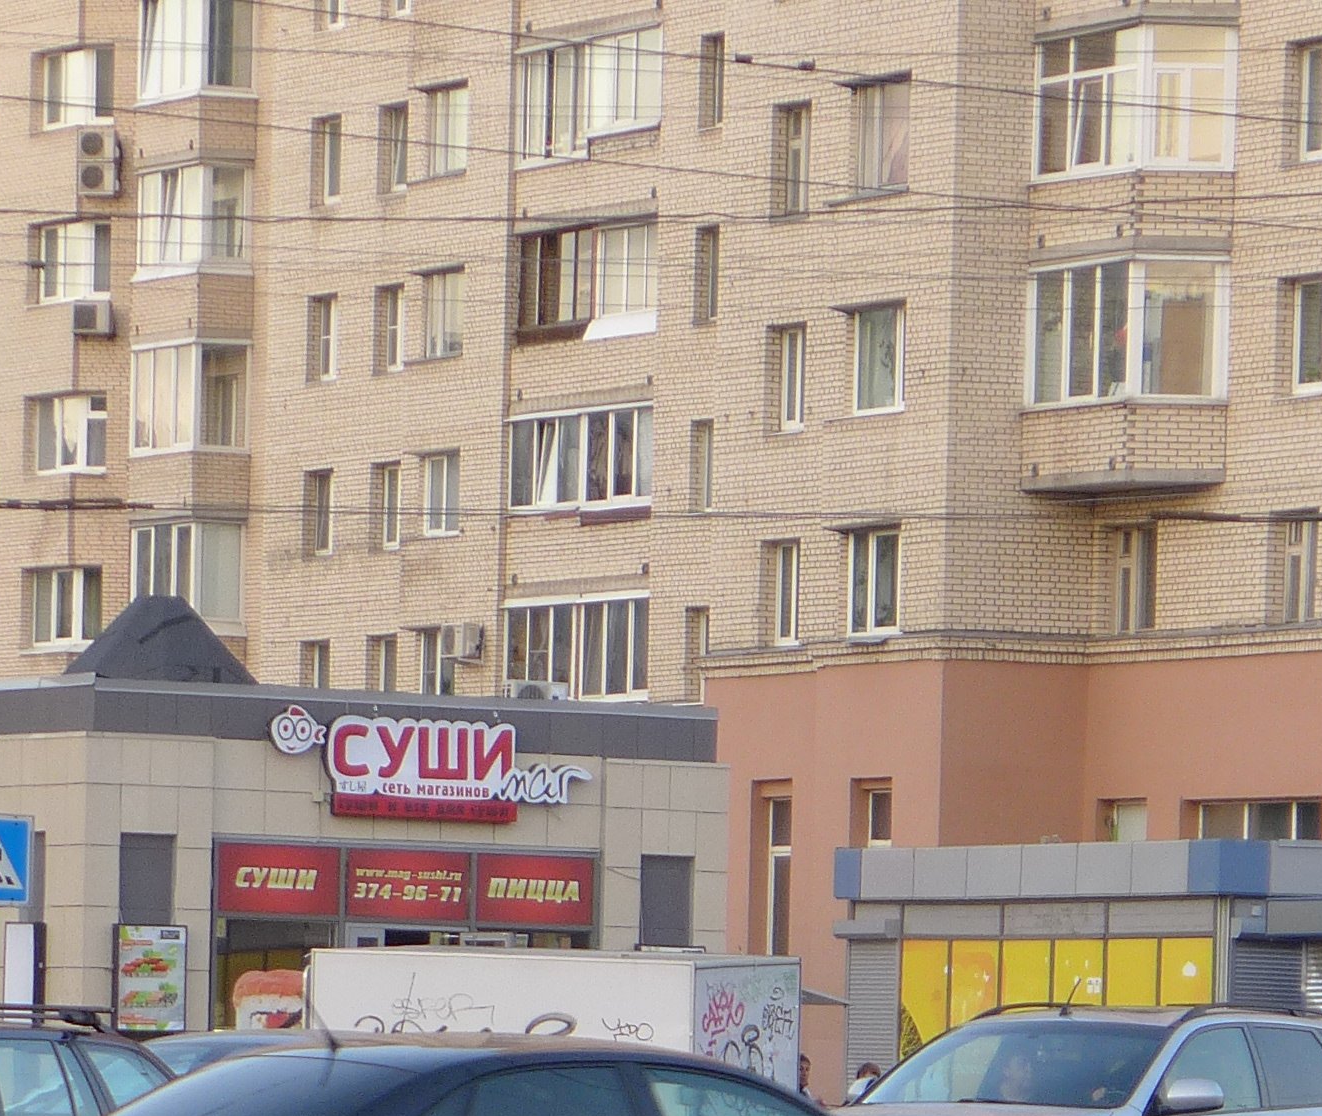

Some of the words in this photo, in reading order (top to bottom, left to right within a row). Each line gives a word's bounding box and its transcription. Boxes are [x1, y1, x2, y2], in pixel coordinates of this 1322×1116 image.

[333, 724, 513, 781] СУШИ
[382, 781, 410, 795] сеть
[417, 783, 490, 799] магазинов
[235, 866, 318, 890] СУШИ
[486, 876, 581, 904] ПИЦЦА
[354, 882, 461, 902] 374-96-71
